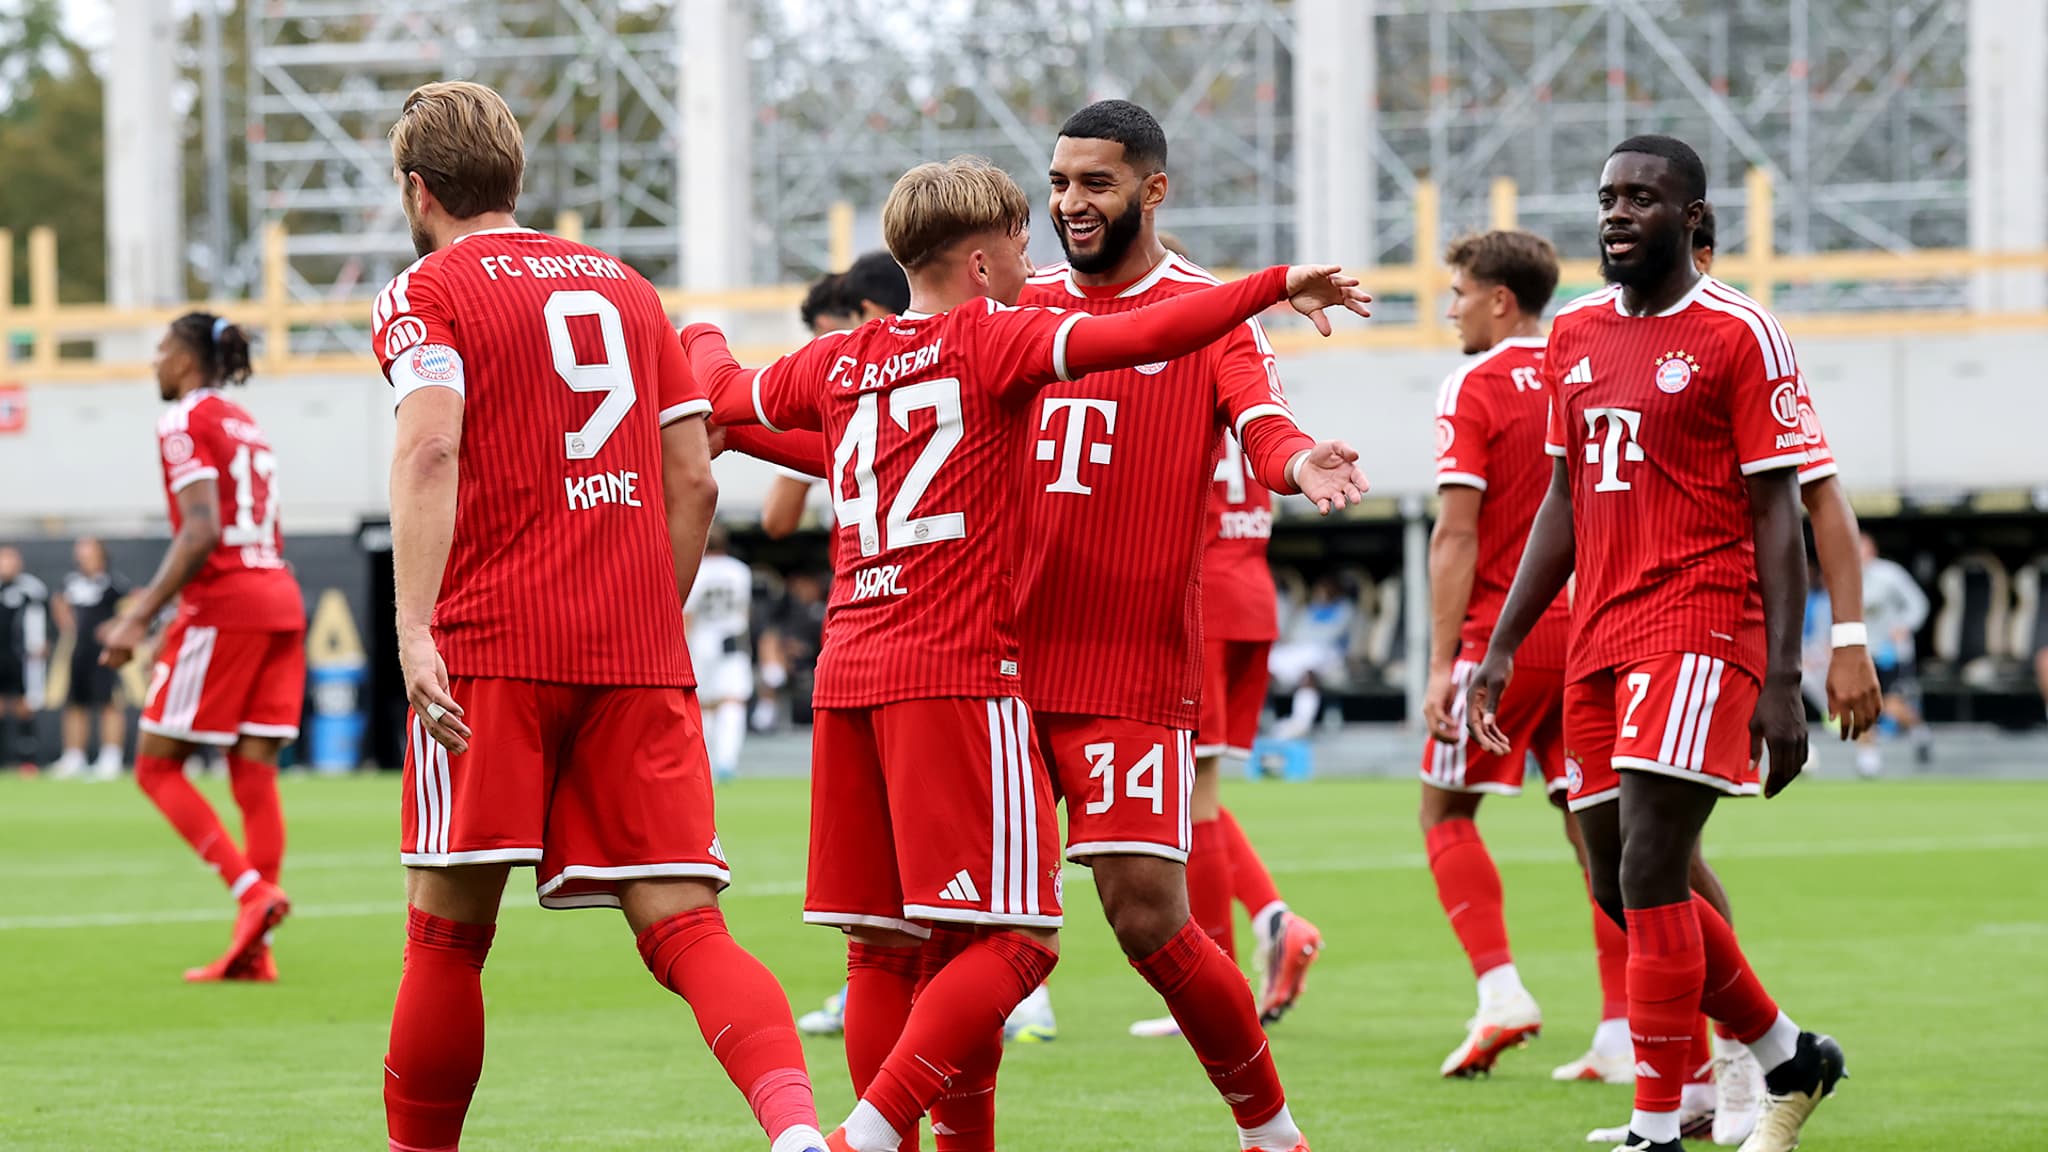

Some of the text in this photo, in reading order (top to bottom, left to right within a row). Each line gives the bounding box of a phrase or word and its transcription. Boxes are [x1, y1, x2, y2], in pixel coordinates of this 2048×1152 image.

[480, 254, 627, 280] FC BAYERN
[543, 290, 637, 460] 9
[828, 355, 858, 388] FC
[1510, 366, 1543, 392] FC
[832, 377, 966, 558] 42
[1036, 397, 1118, 495] T
[1584, 407, 1644, 492] T
[565, 470, 641, 511] KANE
[850, 564, 908, 602] KARL
[1621, 672, 1651, 738] 2
[1084, 742, 1164, 815] 34
